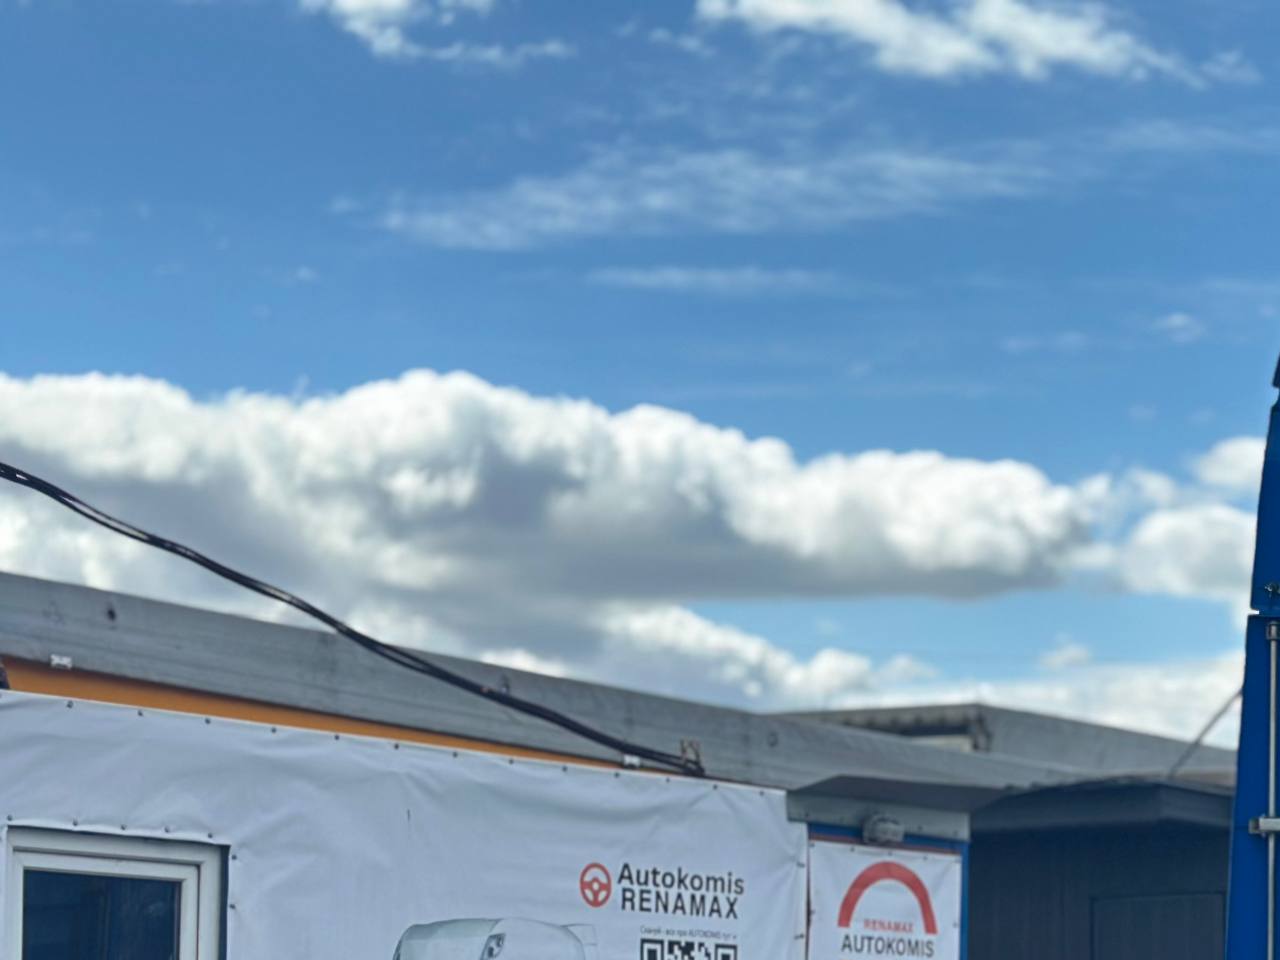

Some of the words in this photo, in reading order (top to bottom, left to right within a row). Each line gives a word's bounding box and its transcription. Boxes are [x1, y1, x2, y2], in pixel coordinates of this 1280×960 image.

[617, 862, 744, 895] Autokomis
[621, 887, 738, 919] RENAMAX
[864, 919, 913, 932] RENAMAX
[841, 934, 934, 957] AUTOKOMIS
